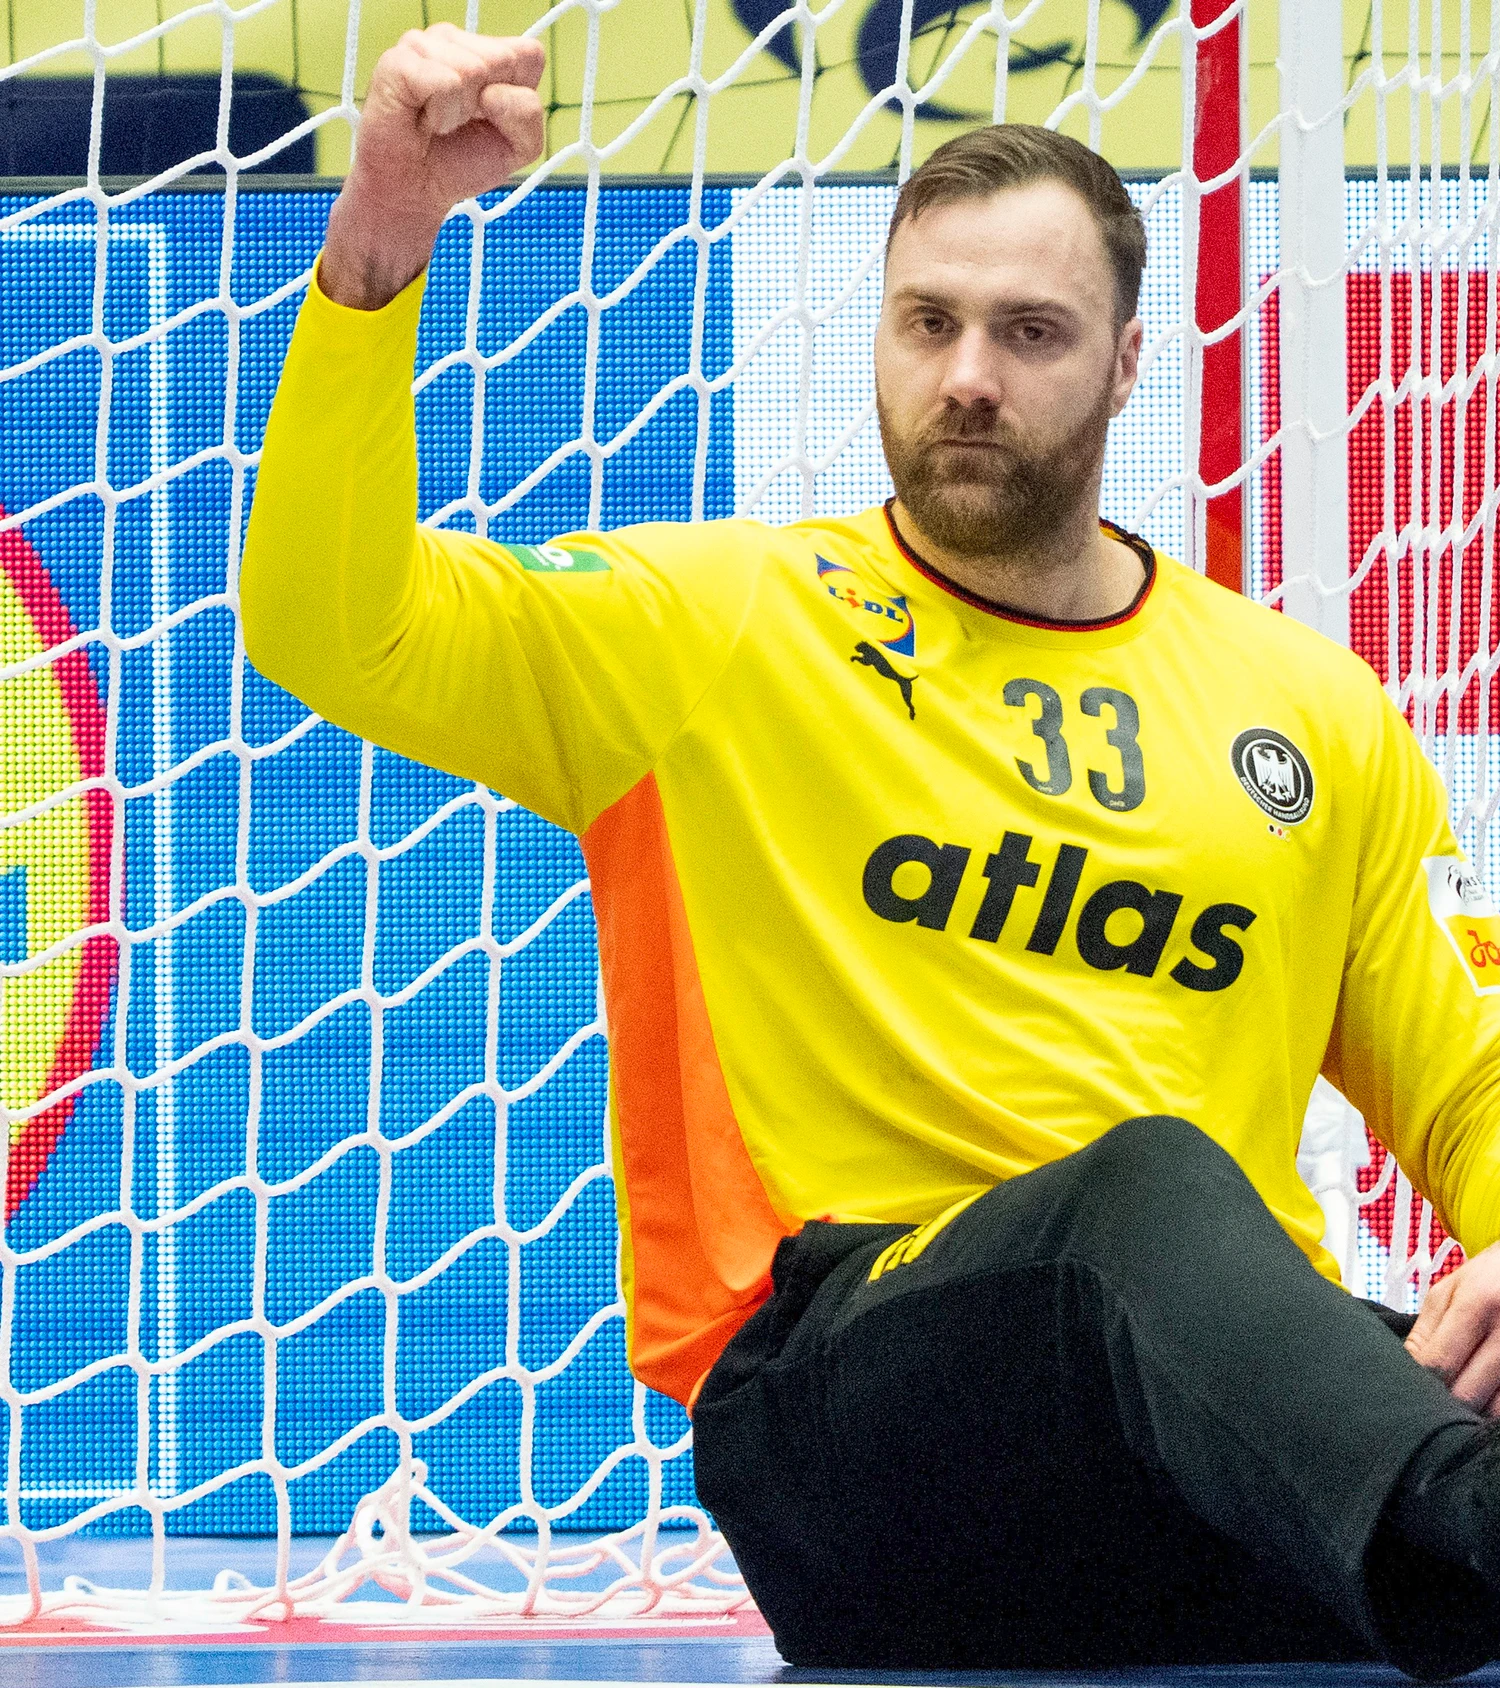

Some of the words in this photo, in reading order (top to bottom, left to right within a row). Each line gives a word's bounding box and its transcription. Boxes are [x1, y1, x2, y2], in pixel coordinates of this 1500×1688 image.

[1002, 677, 1146, 812] 33
[1240, 776, 1273, 813] DEUTSCHER
[862, 830, 1257, 992] atlas
